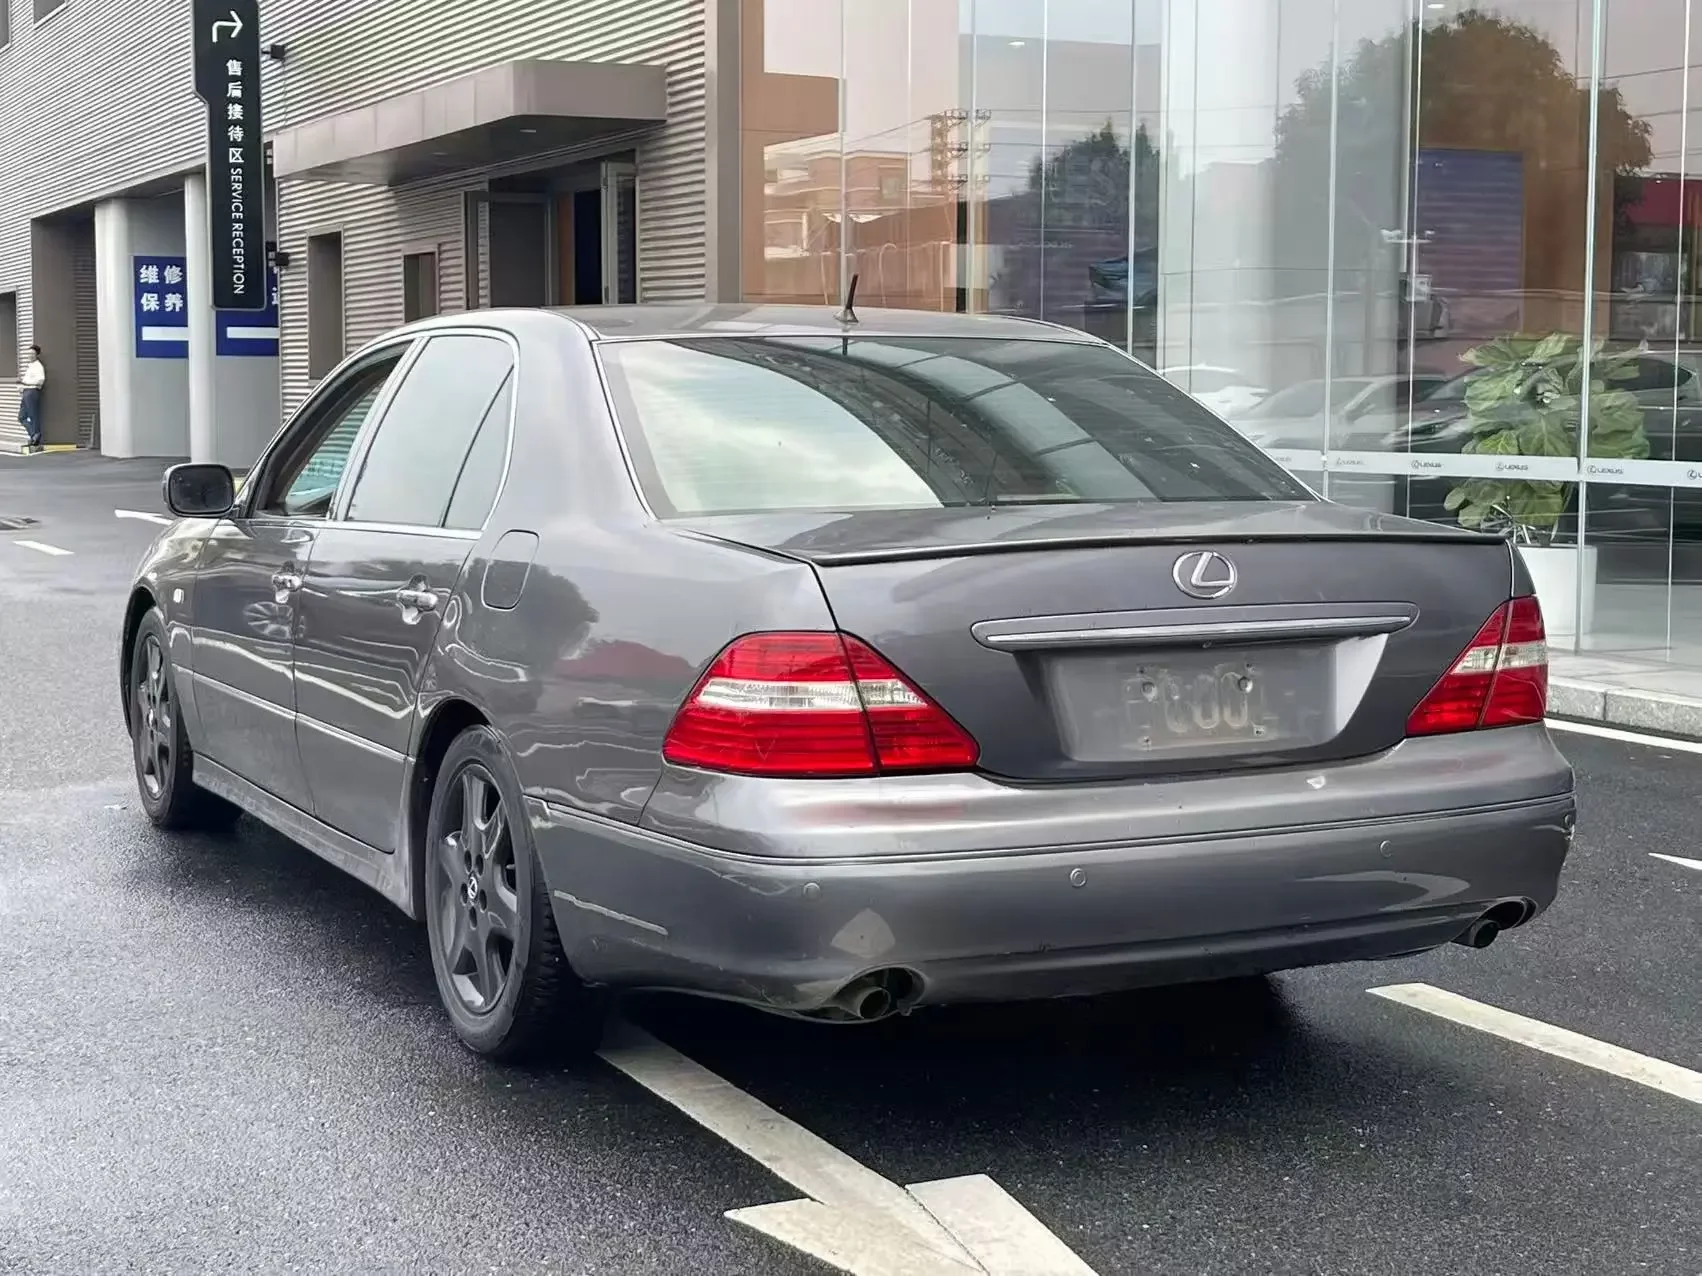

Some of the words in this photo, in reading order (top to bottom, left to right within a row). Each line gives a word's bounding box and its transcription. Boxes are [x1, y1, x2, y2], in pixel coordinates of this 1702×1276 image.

[226, 59, 244, 163] 售后接待区
[230, 168, 243, 219] SERVICE
[139, 265, 183, 284] 维修
[231, 223, 245, 294] RECEPTION
[140, 292, 184, 312] 保养
